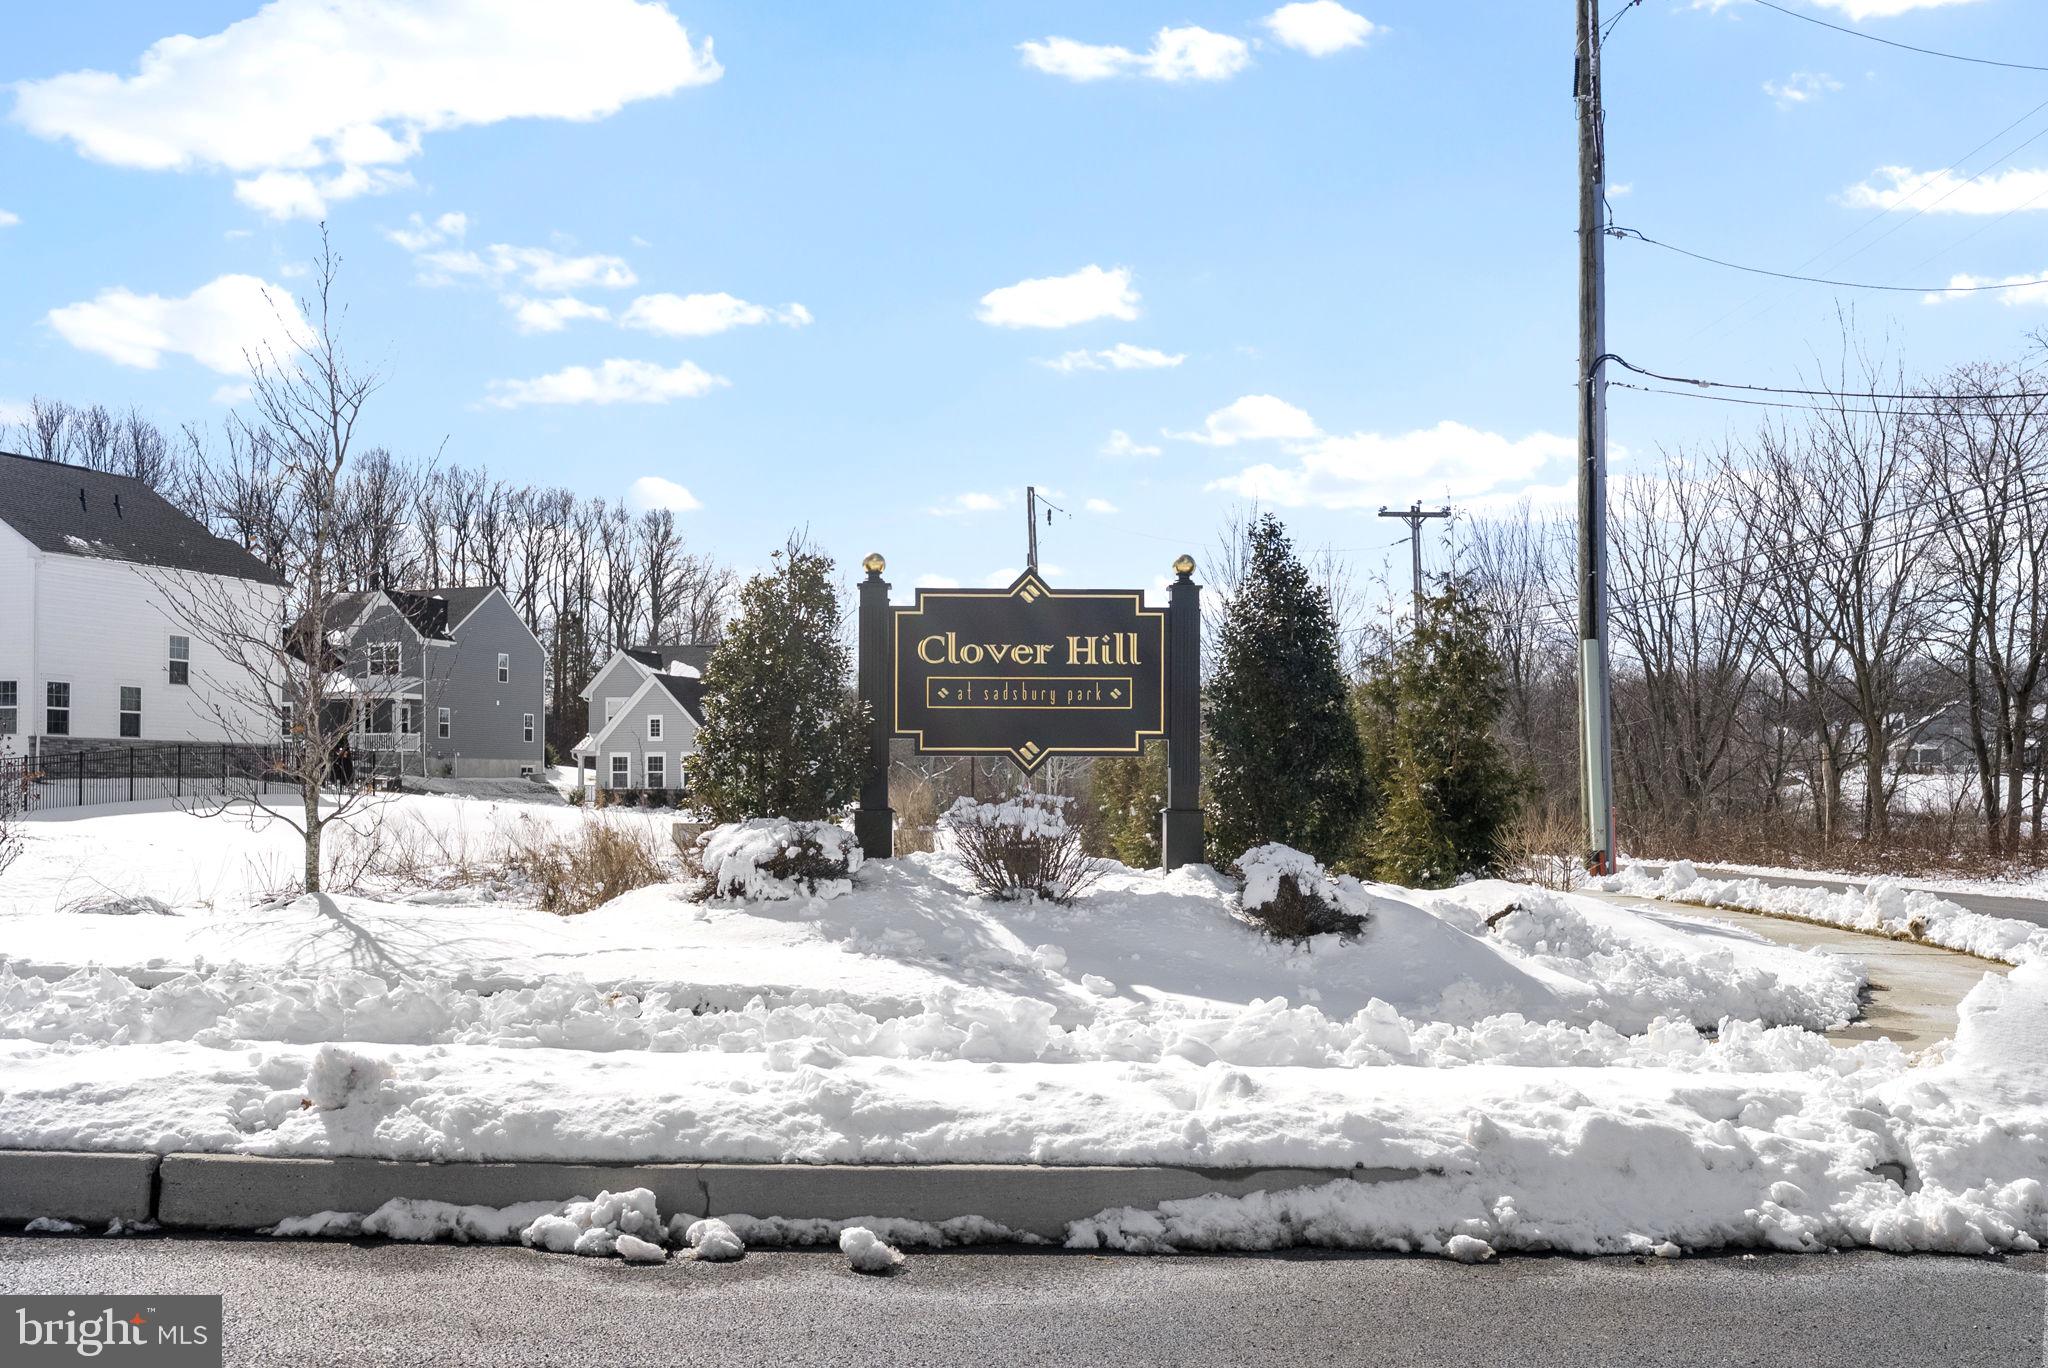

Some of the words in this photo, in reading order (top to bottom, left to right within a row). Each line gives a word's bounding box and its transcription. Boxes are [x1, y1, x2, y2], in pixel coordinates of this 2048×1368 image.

[917, 631, 1054, 664] Clover
[1066, 632, 1142, 665] Hill
[957, 681, 972, 701] at
[983, 681, 1056, 705] sadsbury
[1067, 682, 1102, 705] park
